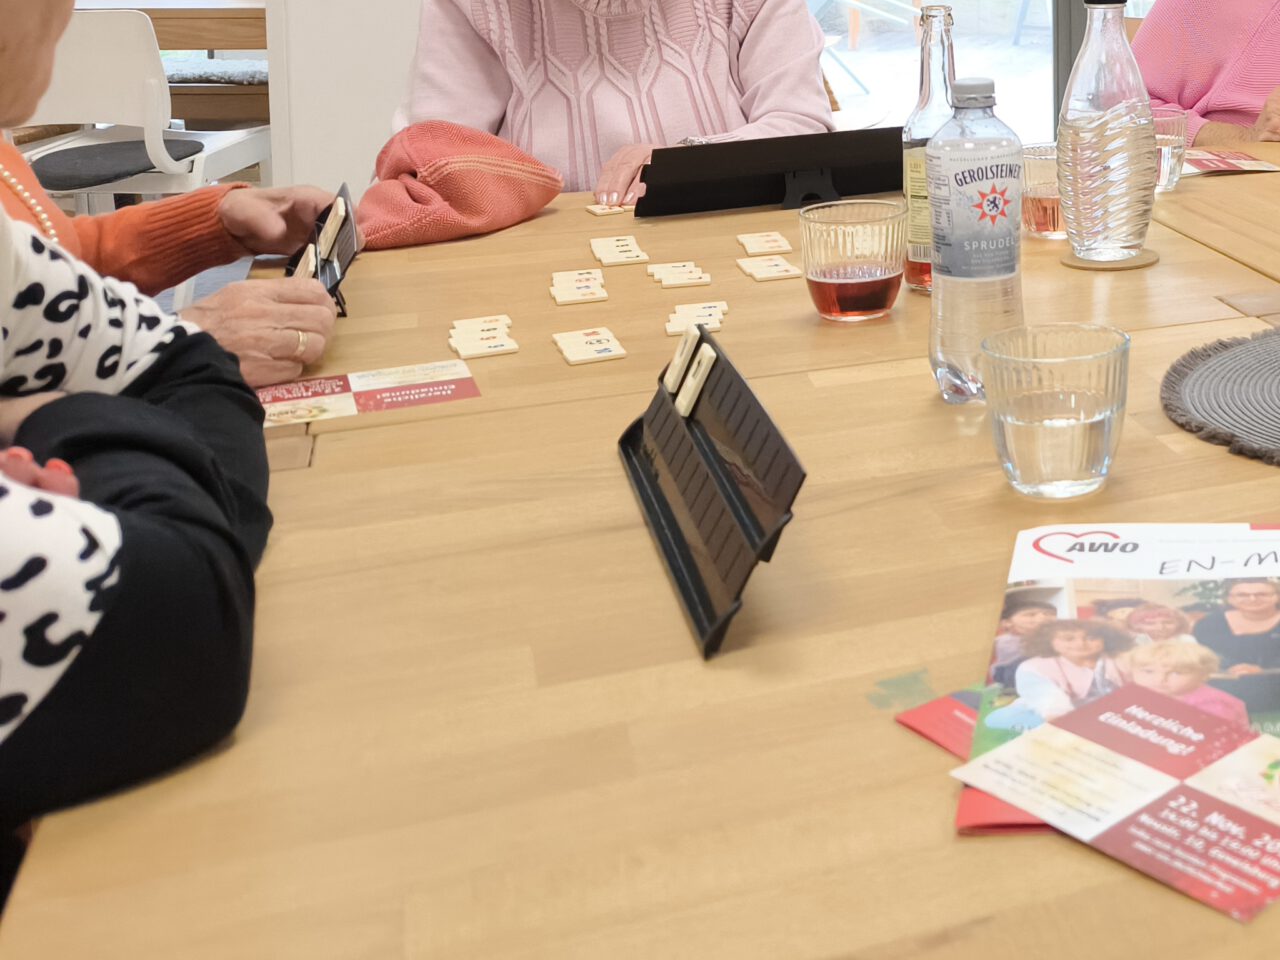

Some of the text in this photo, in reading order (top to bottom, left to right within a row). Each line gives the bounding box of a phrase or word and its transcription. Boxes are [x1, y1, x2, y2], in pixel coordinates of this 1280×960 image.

[964, 237, 1015, 251] SPRUDEL
[1065, 540, 1140, 554] AWO
[1097, 711, 1197, 757] Einladung!
[1124, 704, 1205, 742] Herzliche
